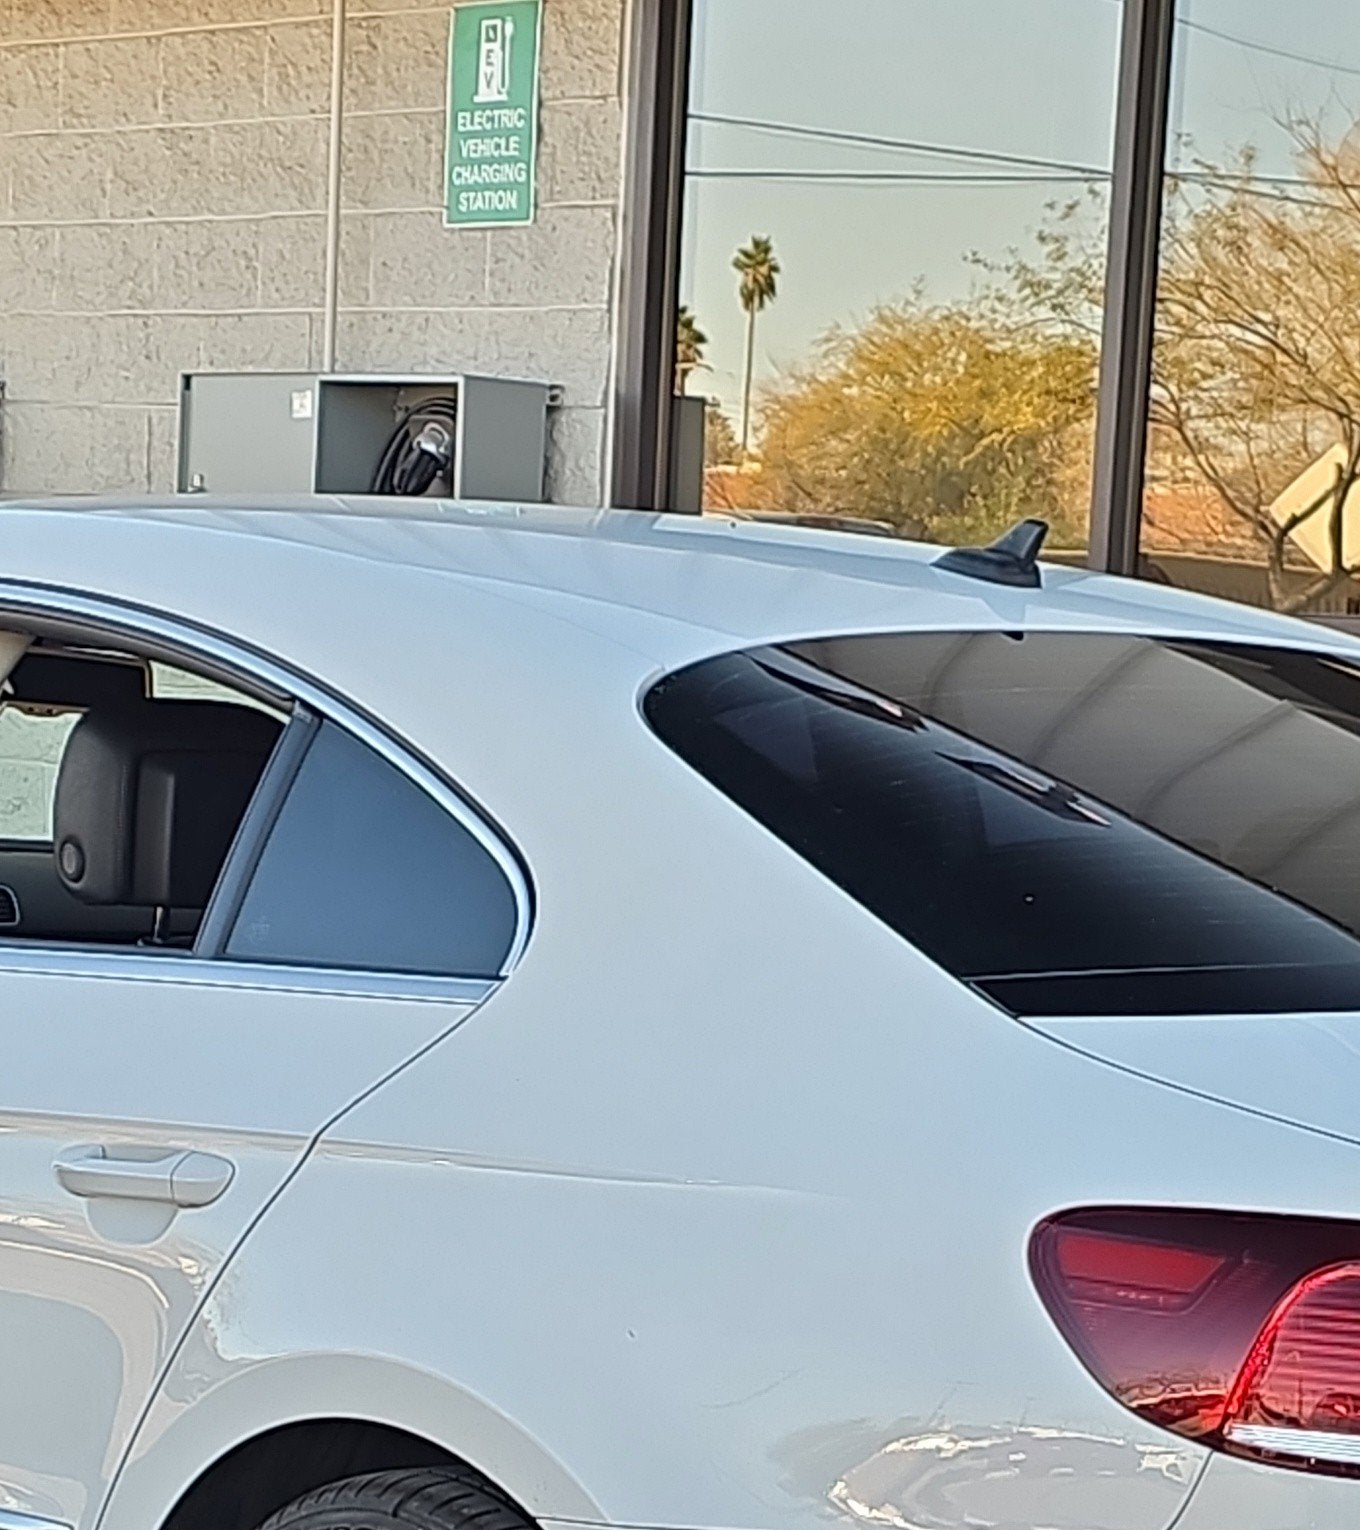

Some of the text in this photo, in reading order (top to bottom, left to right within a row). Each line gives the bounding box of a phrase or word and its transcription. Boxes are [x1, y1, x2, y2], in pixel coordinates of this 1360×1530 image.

[457, 108, 526, 132] ELECTRIC
[460, 136, 520, 158] VEHICLE
[452, 163, 527, 185] CHARGING
[458, 190, 518, 212] STATION
